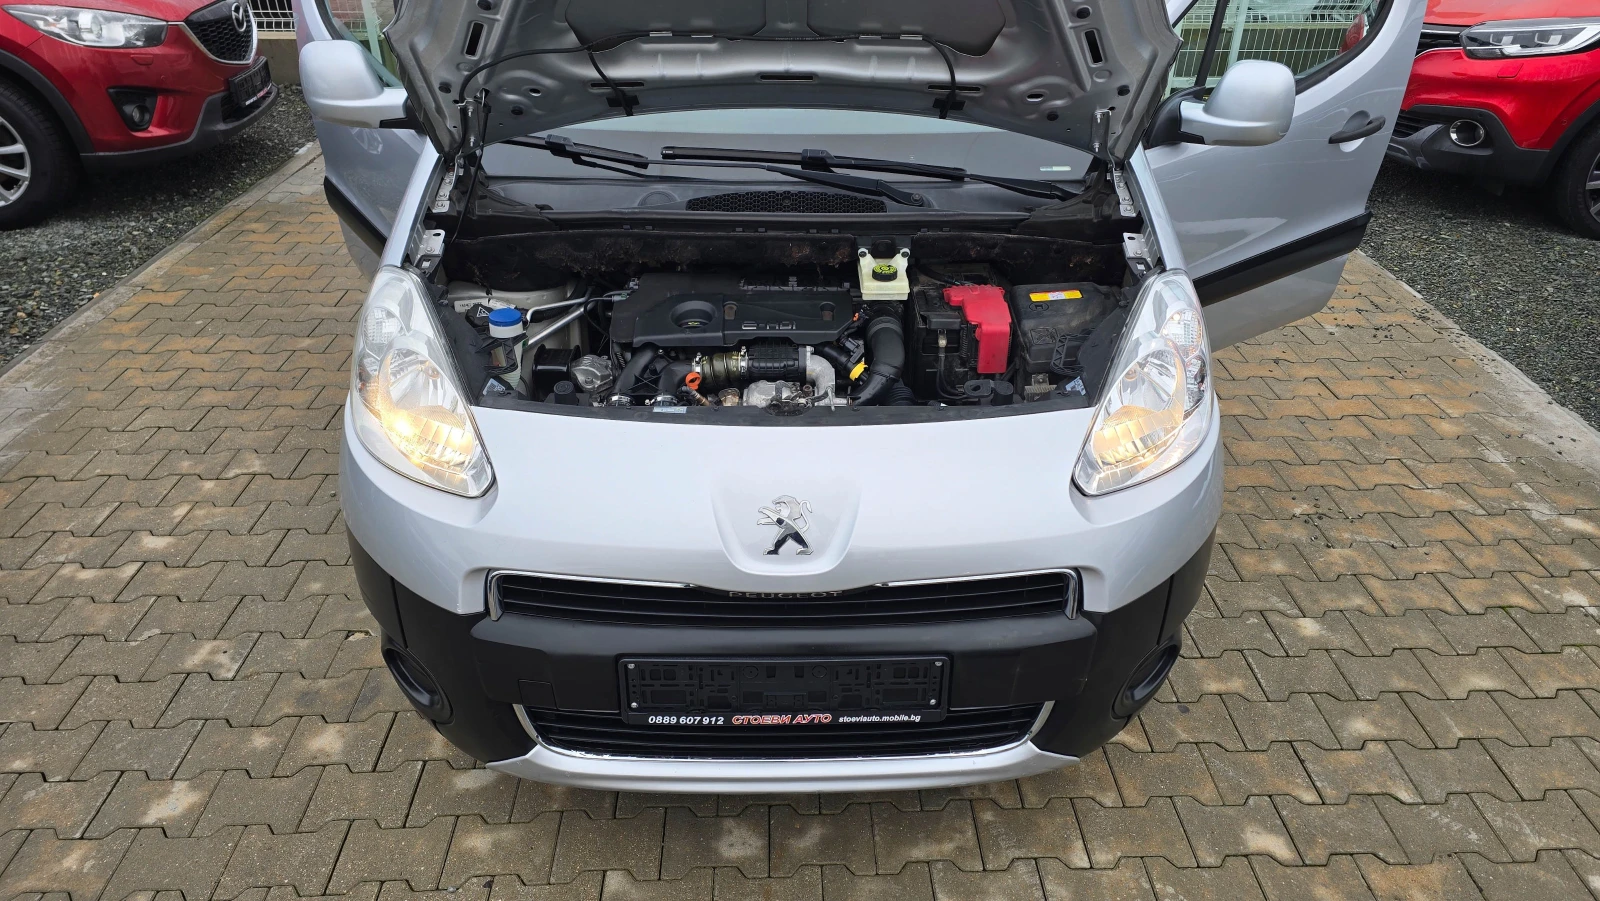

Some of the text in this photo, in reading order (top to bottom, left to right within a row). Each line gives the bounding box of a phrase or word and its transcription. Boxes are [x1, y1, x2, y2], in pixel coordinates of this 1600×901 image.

[728, 591, 843, 599] PEUGEOT
[648, 715, 724, 725] 0889 607 912
[731, 713, 833, 725] СТОЕВИ АУТО
[838, 714, 922, 723] stoeviauto.mobile.bg
